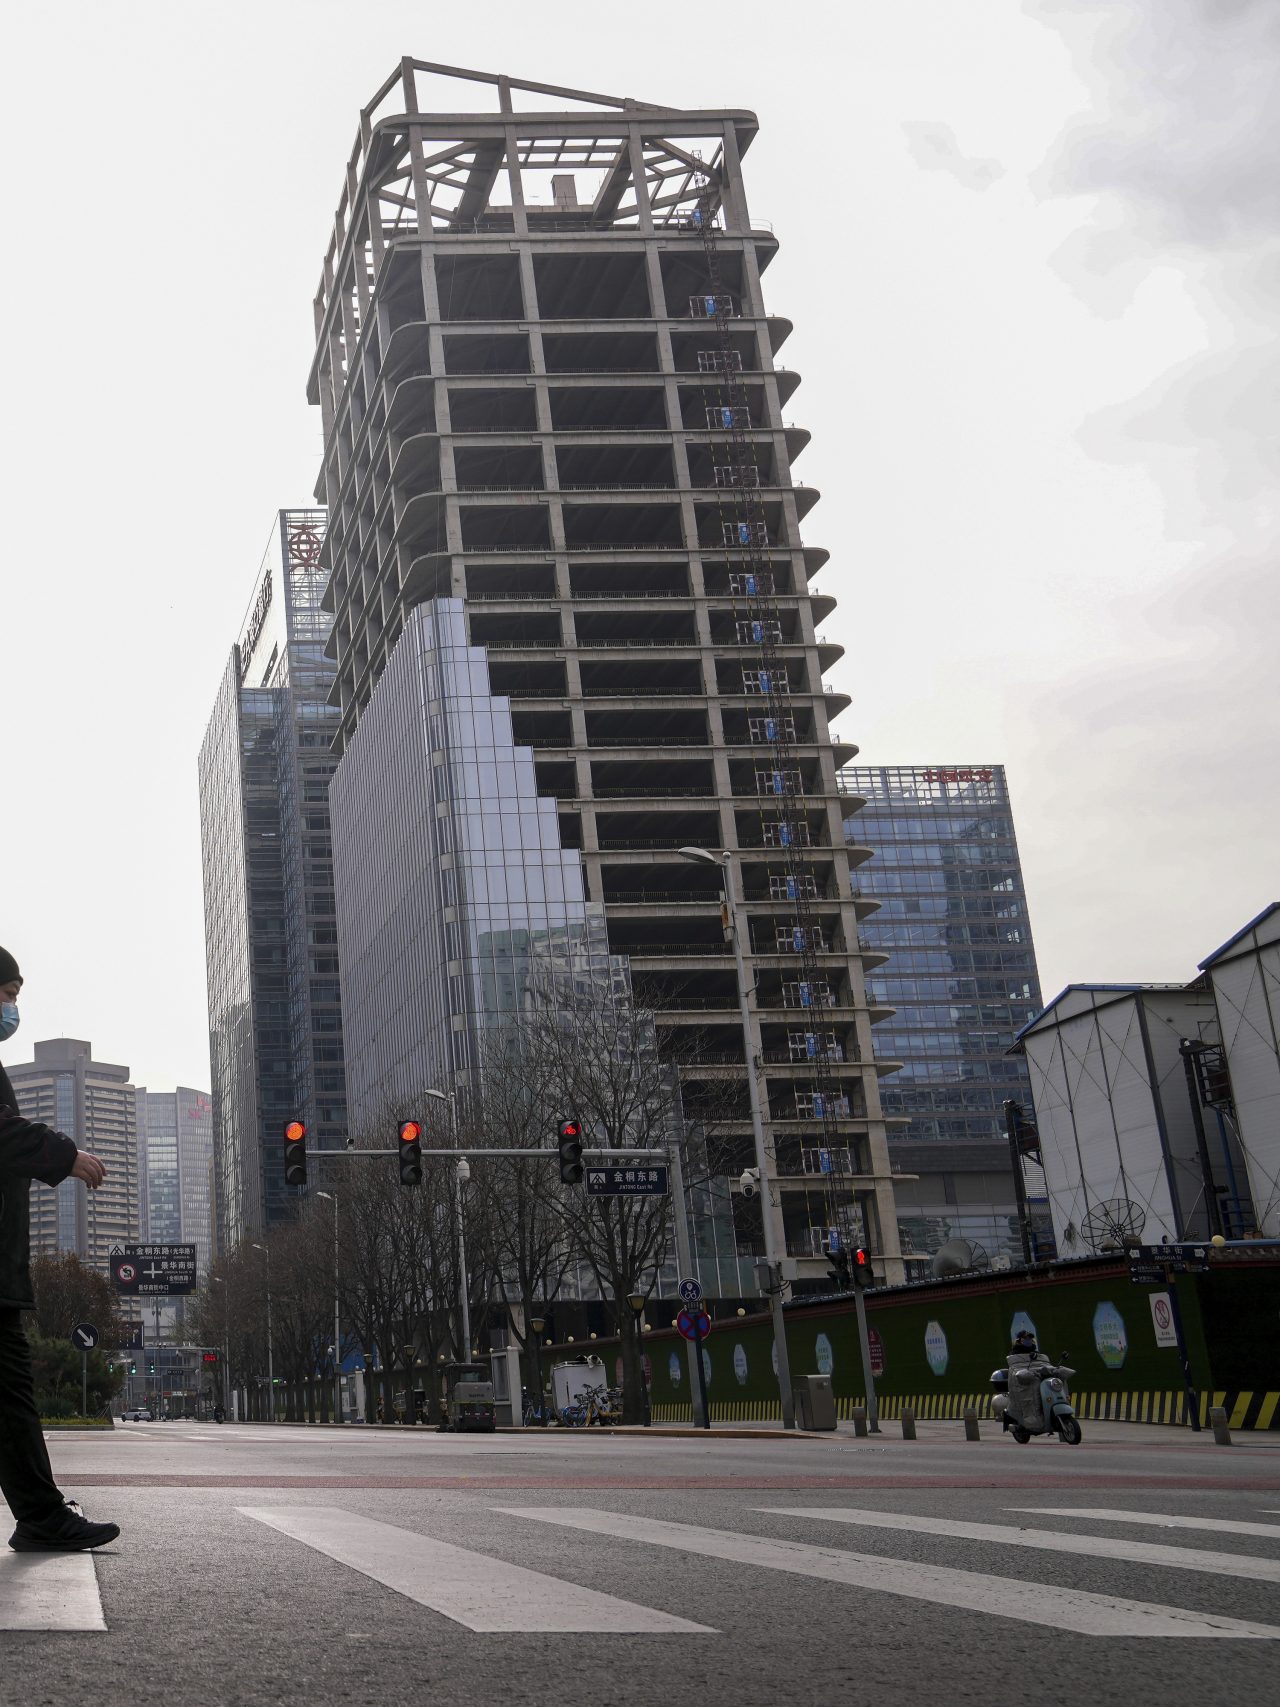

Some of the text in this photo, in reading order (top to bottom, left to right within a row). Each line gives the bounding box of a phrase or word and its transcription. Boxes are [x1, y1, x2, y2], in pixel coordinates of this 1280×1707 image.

[614, 1171, 658, 1182] 金桐东路
[161, 1261, 195, 1269] 景华南街
